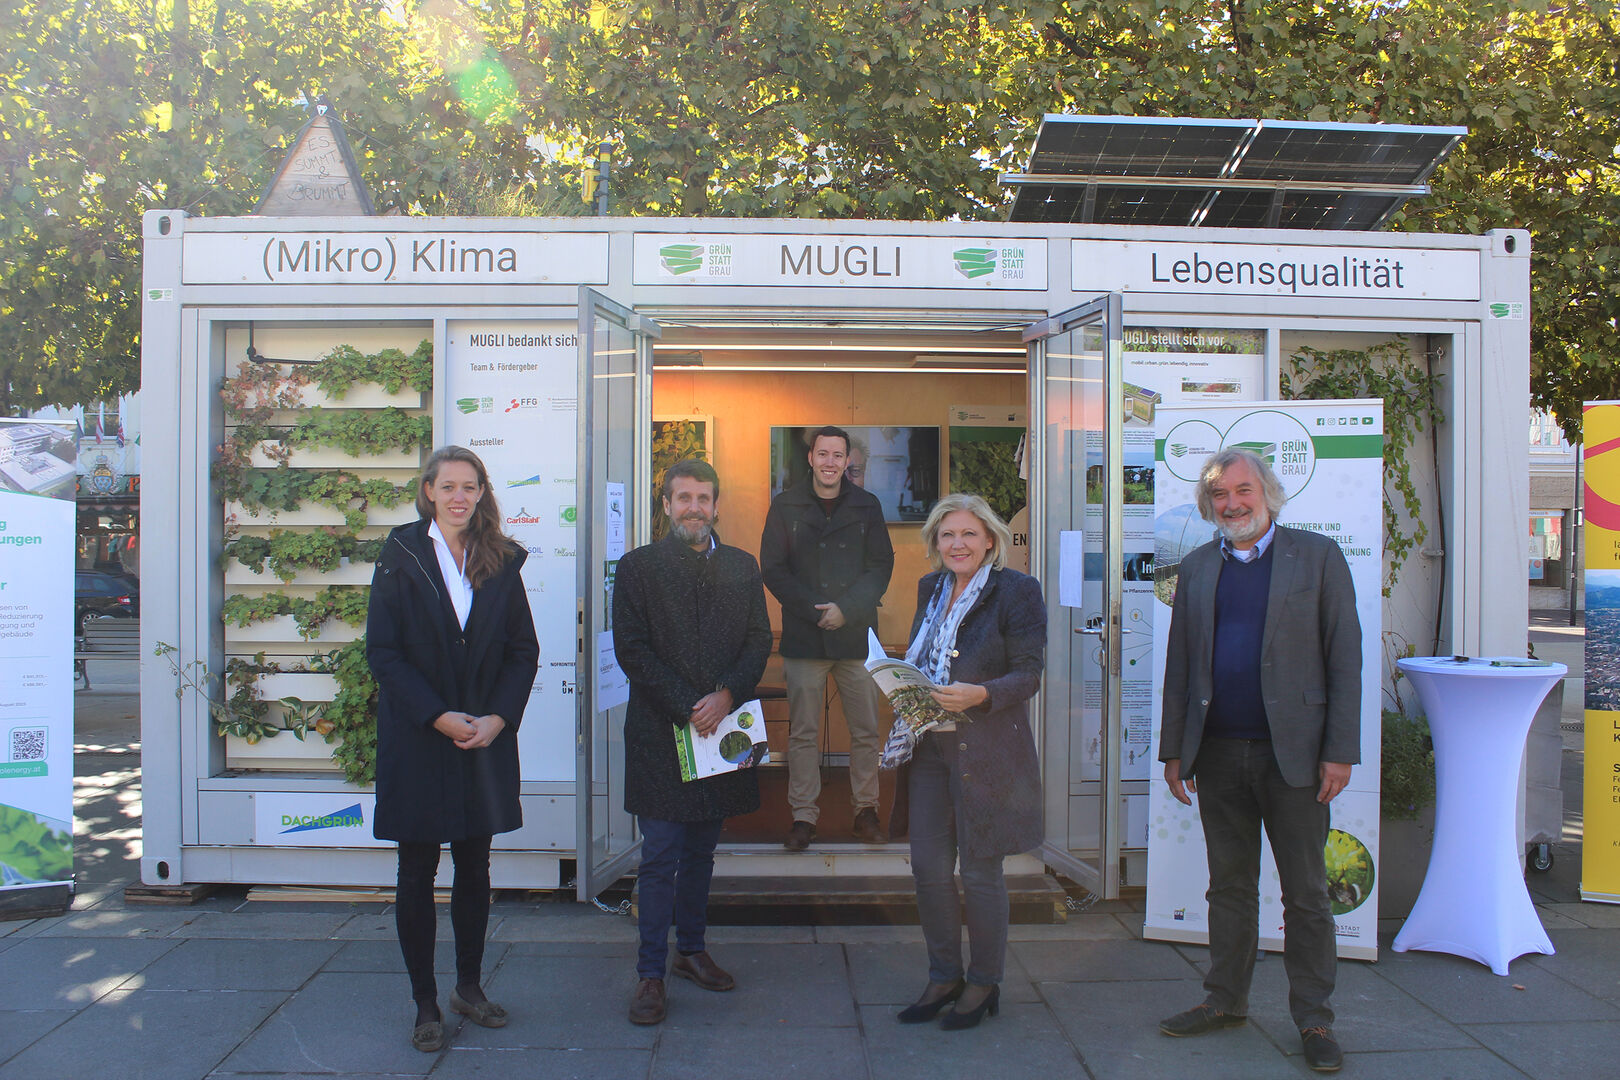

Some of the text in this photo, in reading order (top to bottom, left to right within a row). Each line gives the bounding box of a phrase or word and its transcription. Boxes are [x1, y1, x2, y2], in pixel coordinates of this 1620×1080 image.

[709, 243, 732, 255] GRÜN
[1001, 247, 1025, 259] GRÜN
[262, 237, 517, 282] (Mikro) Klima
[709, 256, 732, 265] STATT
[781, 245, 901, 277] MUGLI
[1001, 259, 1025, 269] STATT
[709, 266, 732, 276] GRAU
[1001, 270, 1024, 280] GRAU
[1151, 252, 1405, 293] Lebensqualität
[470, 334, 578, 347] MUGLI bedankt sich
[1122, 331, 1225, 347] UGLI stellt sich vor
[470, 363, 488, 371] Team
[497, 362, 538, 372] Fördergeber
[521, 398, 538, 406] FFG
[469, 438, 504, 446] Aussteller
[1281, 440, 1308, 452] GRÜN
[1281, 453, 1308, 464] STATT
[1281, 465, 1307, 476] GRAU
[1324, 522, 1341, 531] UND
[20, 621, 35, 629] und
[281, 815, 363, 828] DACHGRÜN
